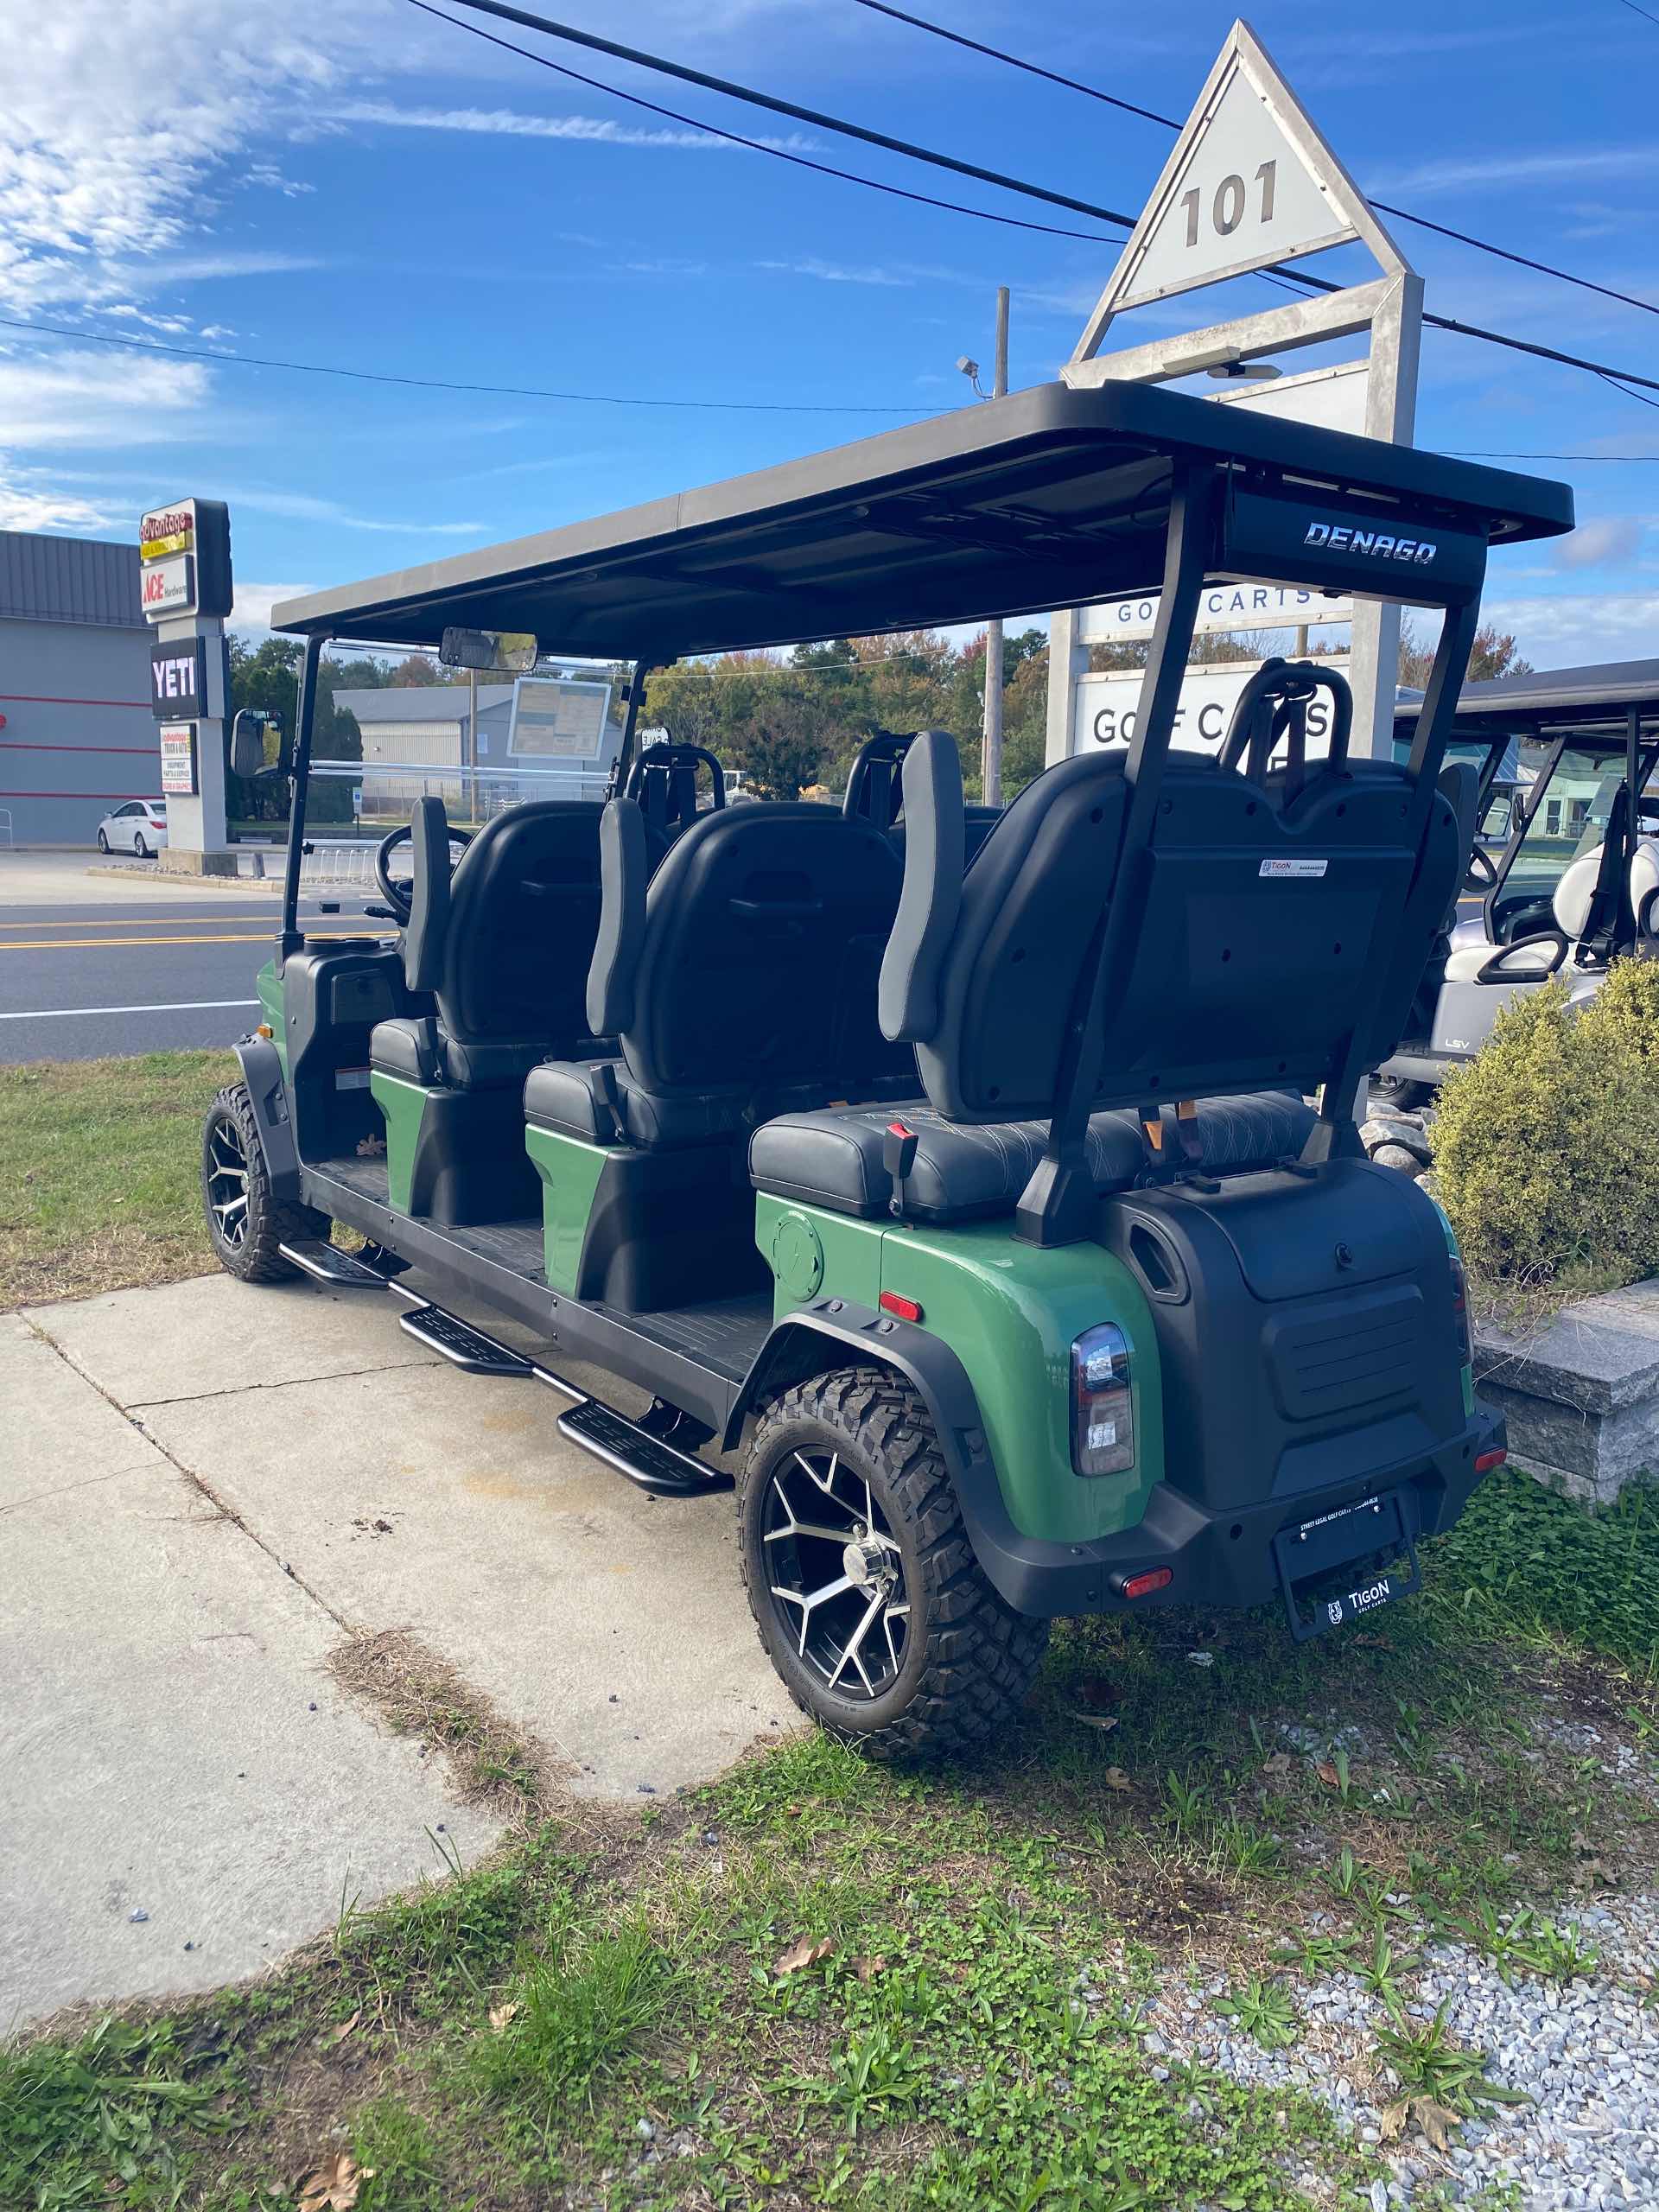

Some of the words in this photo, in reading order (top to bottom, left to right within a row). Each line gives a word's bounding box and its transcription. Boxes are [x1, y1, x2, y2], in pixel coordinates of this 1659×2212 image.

[1180, 159, 1276, 247] 101
[139, 512, 186, 541] advantage
[1304, 523, 1436, 564] DENAGO
[143, 574, 163, 603] ACE
[1208, 589, 1311, 613] CARTS
[152, 657, 194, 698] YETI
[1093, 709, 1186, 743] GOF
[1445, 1038, 1470, 1049] LSV
[1300, 1521, 1315, 1531] STREET
[1315, 1516, 1328, 1525] LEGAL
[1327, 1512, 1338, 1521] GOLF
[1348, 1579, 1390, 1609] TIGON
